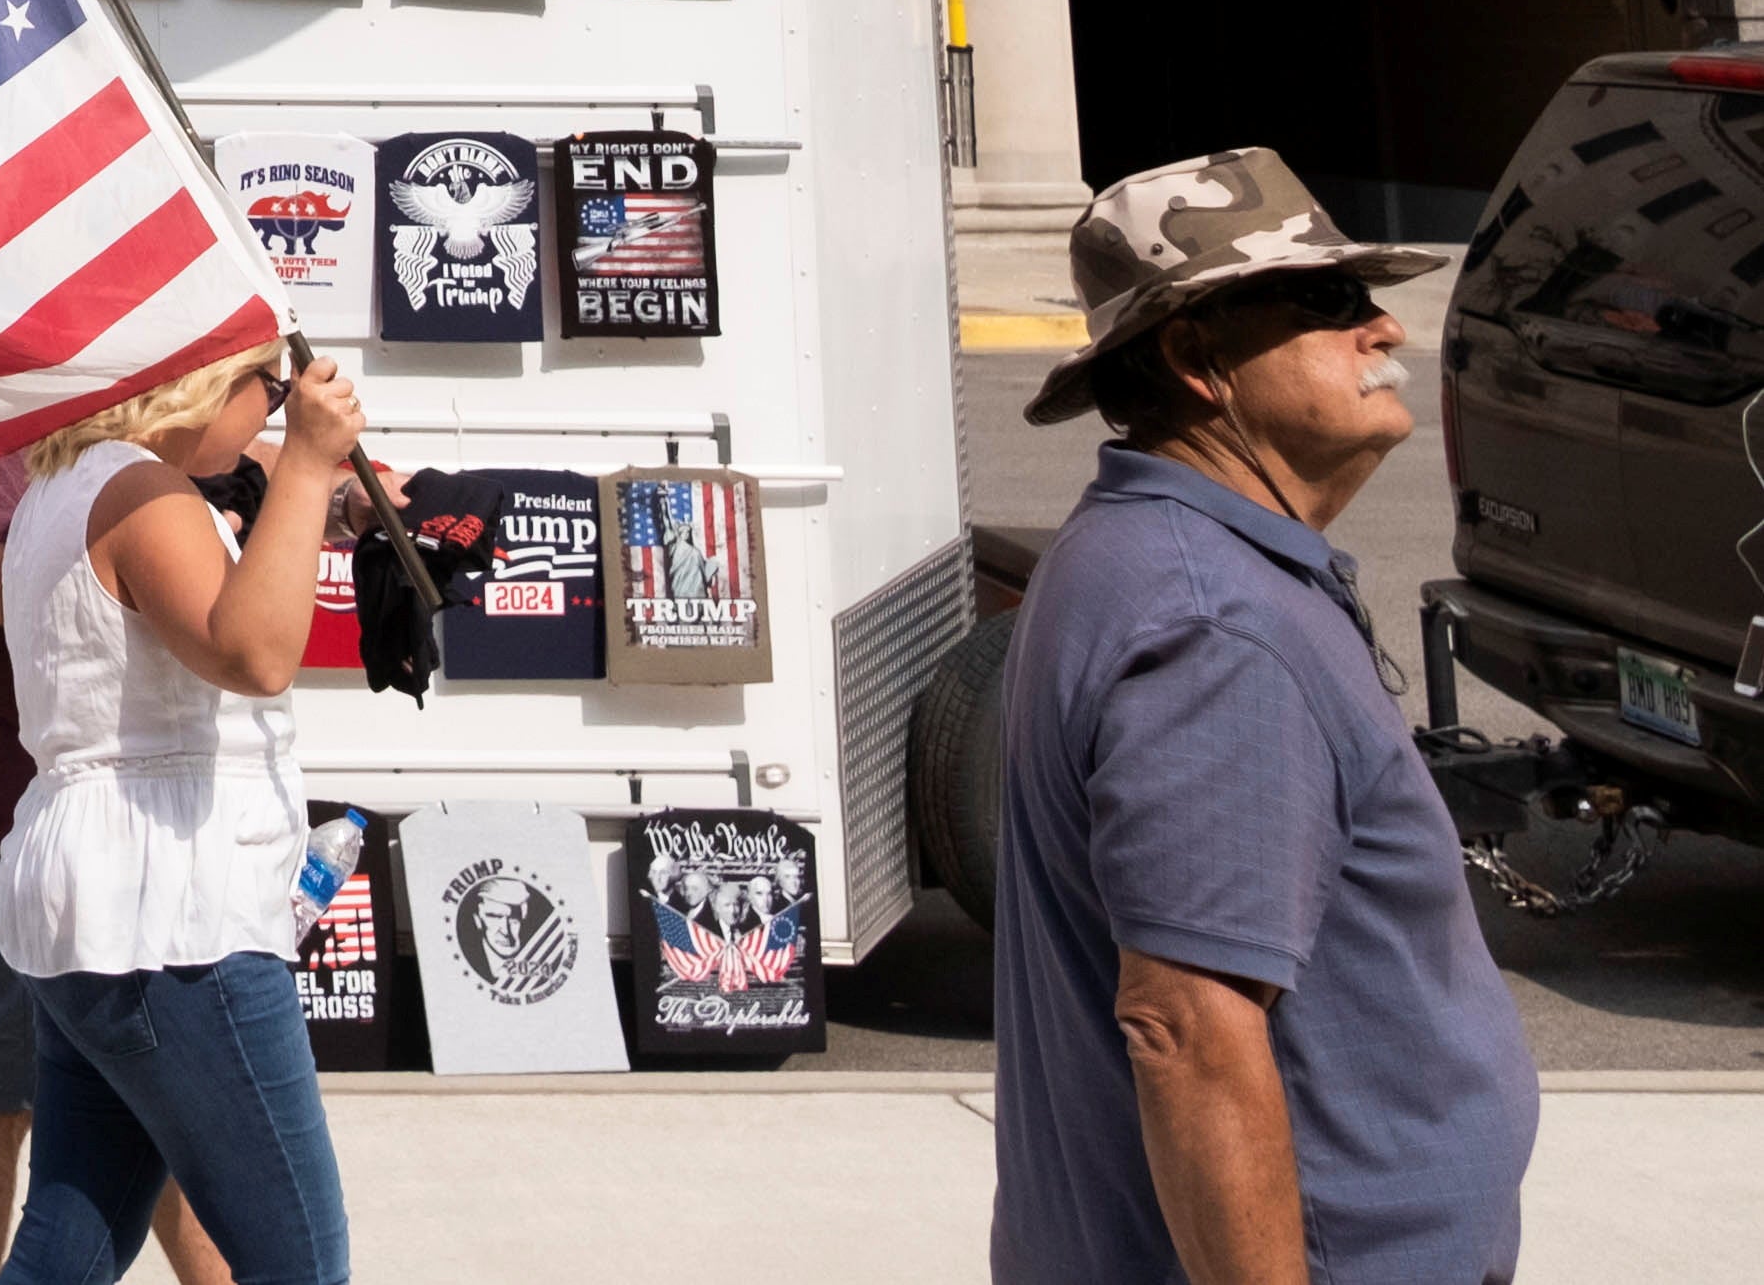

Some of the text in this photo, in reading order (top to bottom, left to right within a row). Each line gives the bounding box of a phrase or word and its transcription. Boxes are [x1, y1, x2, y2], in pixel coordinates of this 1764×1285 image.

[569, 143, 696, 154] MY RIGHTS DON'T
[418, 147, 505, 178] DON'T BLAME
[572, 155, 698, 190] END
[240, 164, 354, 193] IT'S RINO SEASON
[275, 267, 310, 279] OUT!
[283, 257, 306, 266] VOTE
[310, 258, 337, 266] THEM
[443, 263, 449, 278] I
[427, 278, 503, 313] Trump
[578, 278, 707, 289] WHERE YOUR FEELINGS
[577, 291, 708, 325] BEGIN
[514, 492, 592, 511] President
[1478, 497, 1536, 532] EXCURSION
[495, 585, 553, 610] 2024
[626, 598, 757, 622] TRUMP
[639, 625, 704, 635] PROMISES
[642, 635, 745, 646] PROMISES KEPT
[644, 820, 686, 861] We
[715, 822, 788, 864] People
[442, 858, 503, 904] TRUMP
[332, 970, 376, 994] FOR
[490, 973, 568, 1005] Take America
[299, 996, 374, 1019] CROSS
[655, 996, 809, 1036] The Deplorables
